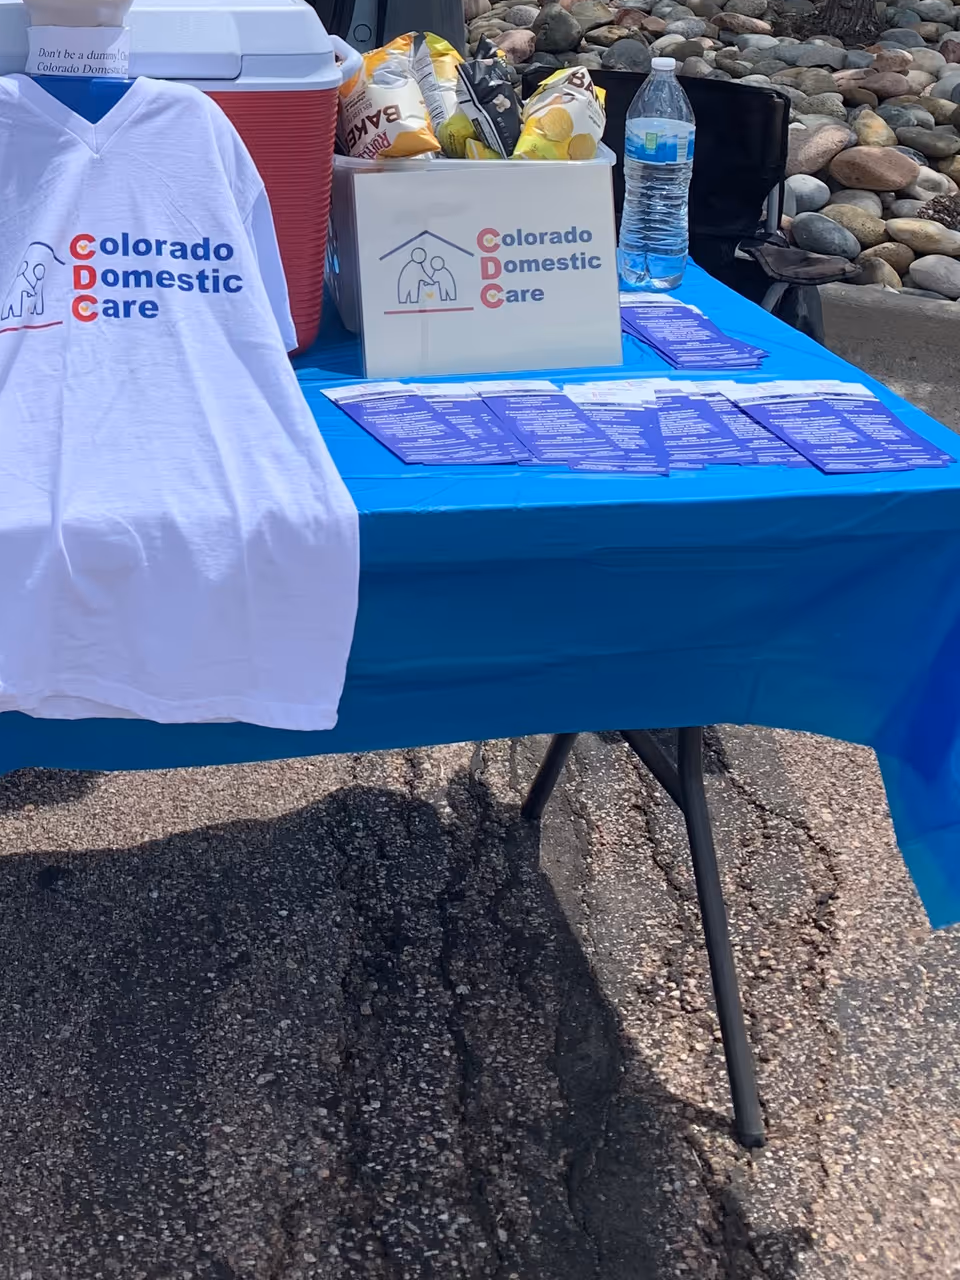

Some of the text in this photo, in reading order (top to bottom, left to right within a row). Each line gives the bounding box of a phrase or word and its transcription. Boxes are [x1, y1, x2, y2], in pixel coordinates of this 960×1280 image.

[38, 47, 61, 59] Don't
[63, 49, 76, 60] be
[78, 52, 84, 60] a
[36, 62, 80, 74] Colorado
[69, 232, 234, 261] Colorado
[476, 226, 593, 254] Colorado
[72, 264, 244, 294] Domestic
[480, 252, 602, 280] Domestic
[71, 294, 160, 323] Care
[480, 283, 545, 309] Care
